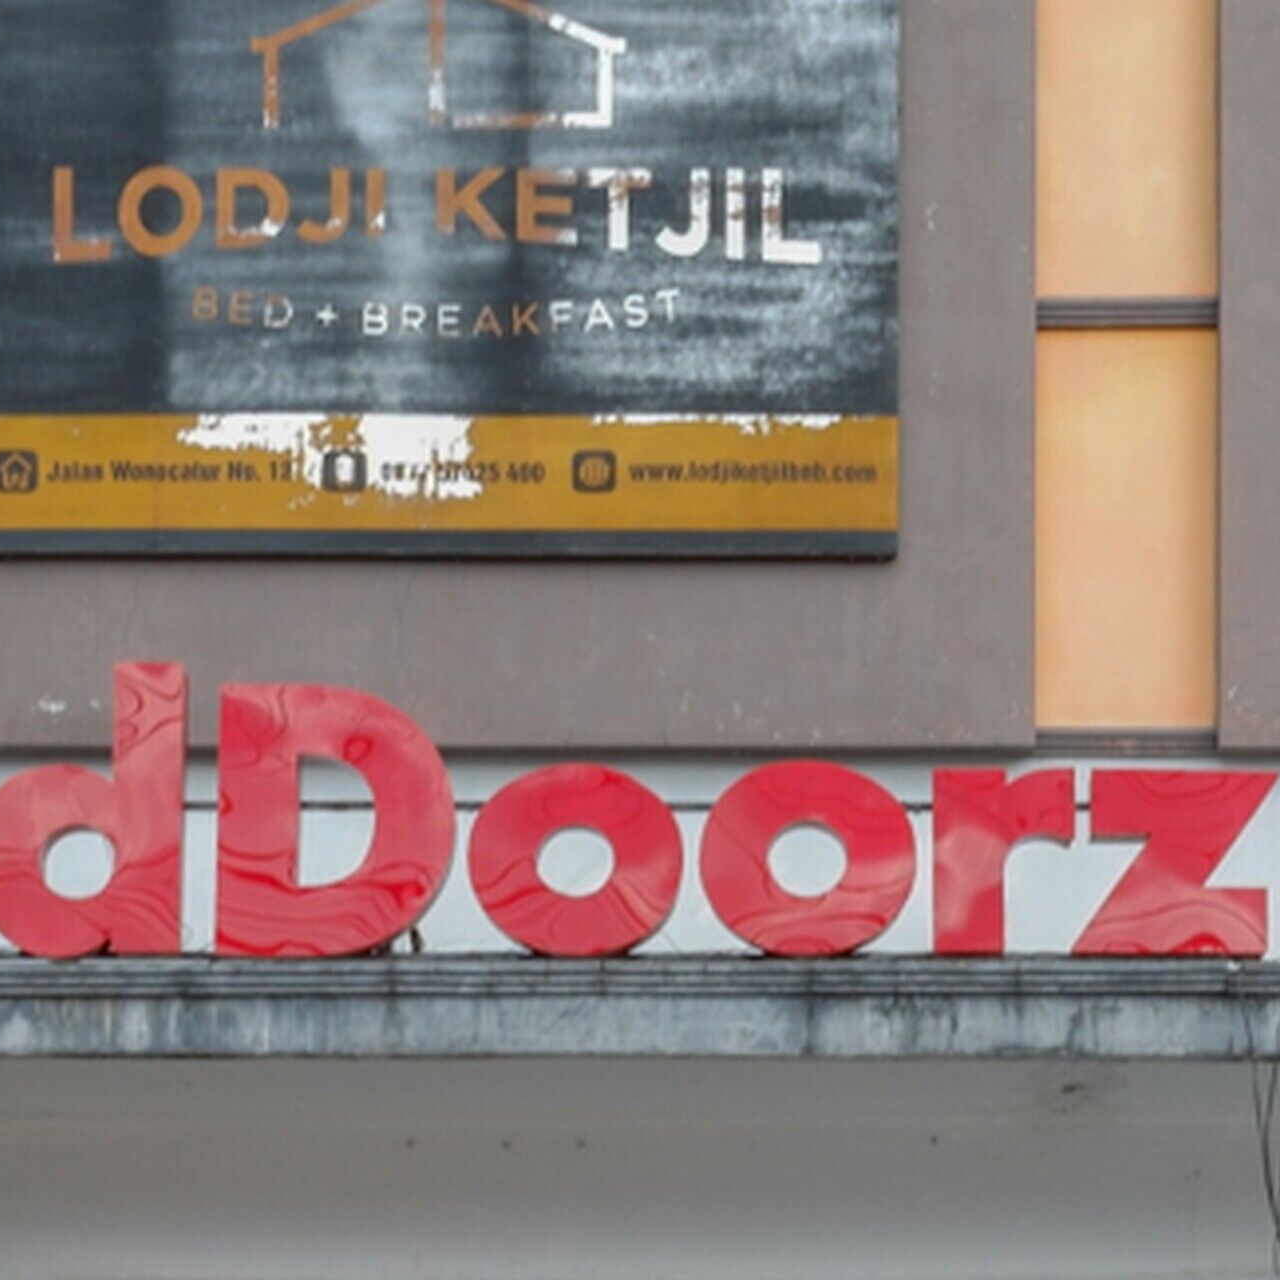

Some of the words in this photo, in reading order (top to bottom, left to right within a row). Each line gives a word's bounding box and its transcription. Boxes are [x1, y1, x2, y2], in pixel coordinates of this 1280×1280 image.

[53, 165, 386, 264] LODJI
[434, 165, 822, 265] KETJIL
[191, 285, 294, 329] BED
[361, 288, 681, 338] BREAKFAST
[46, 459, 104, 482] Jalan
[227, 459, 262, 482] No.
